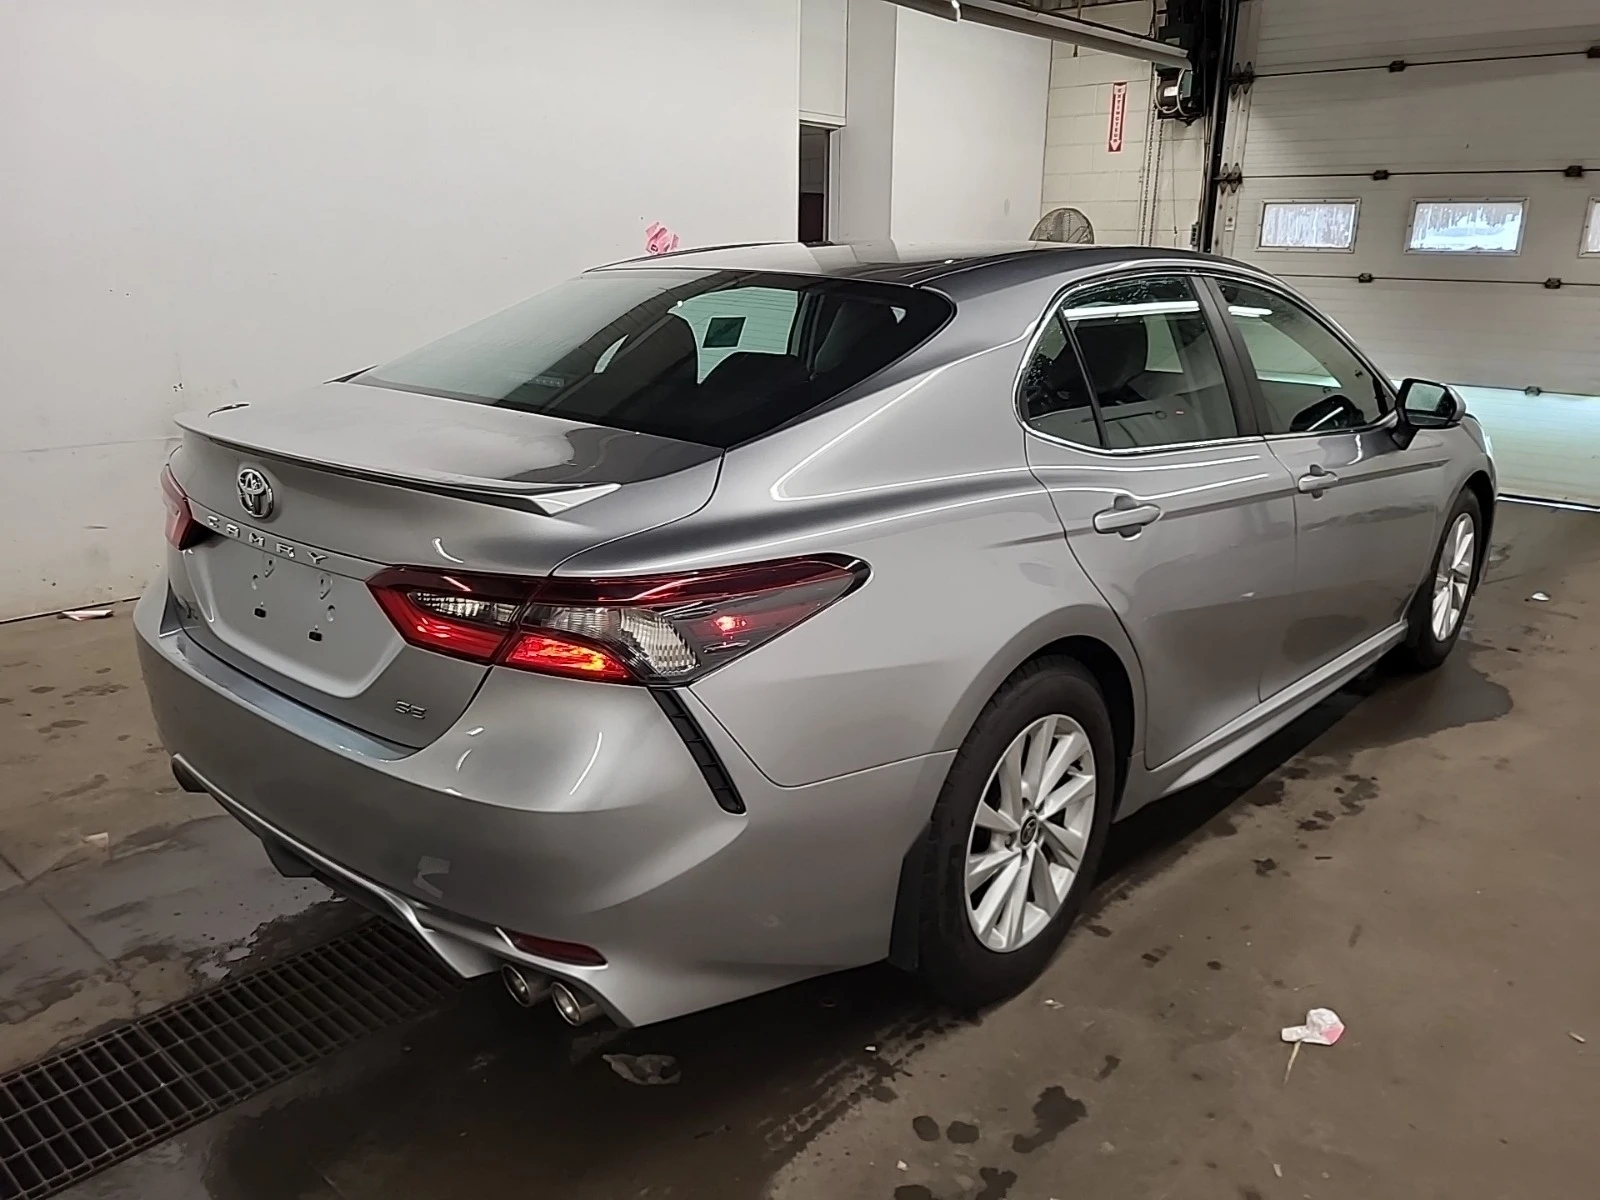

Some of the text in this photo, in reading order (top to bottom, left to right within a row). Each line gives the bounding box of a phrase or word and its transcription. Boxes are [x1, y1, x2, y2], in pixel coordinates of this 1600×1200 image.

[1113, 88, 1121, 143] EXTINCTEUR
[207, 515, 328, 565] CAMRY
[395, 700, 426, 719] SE
